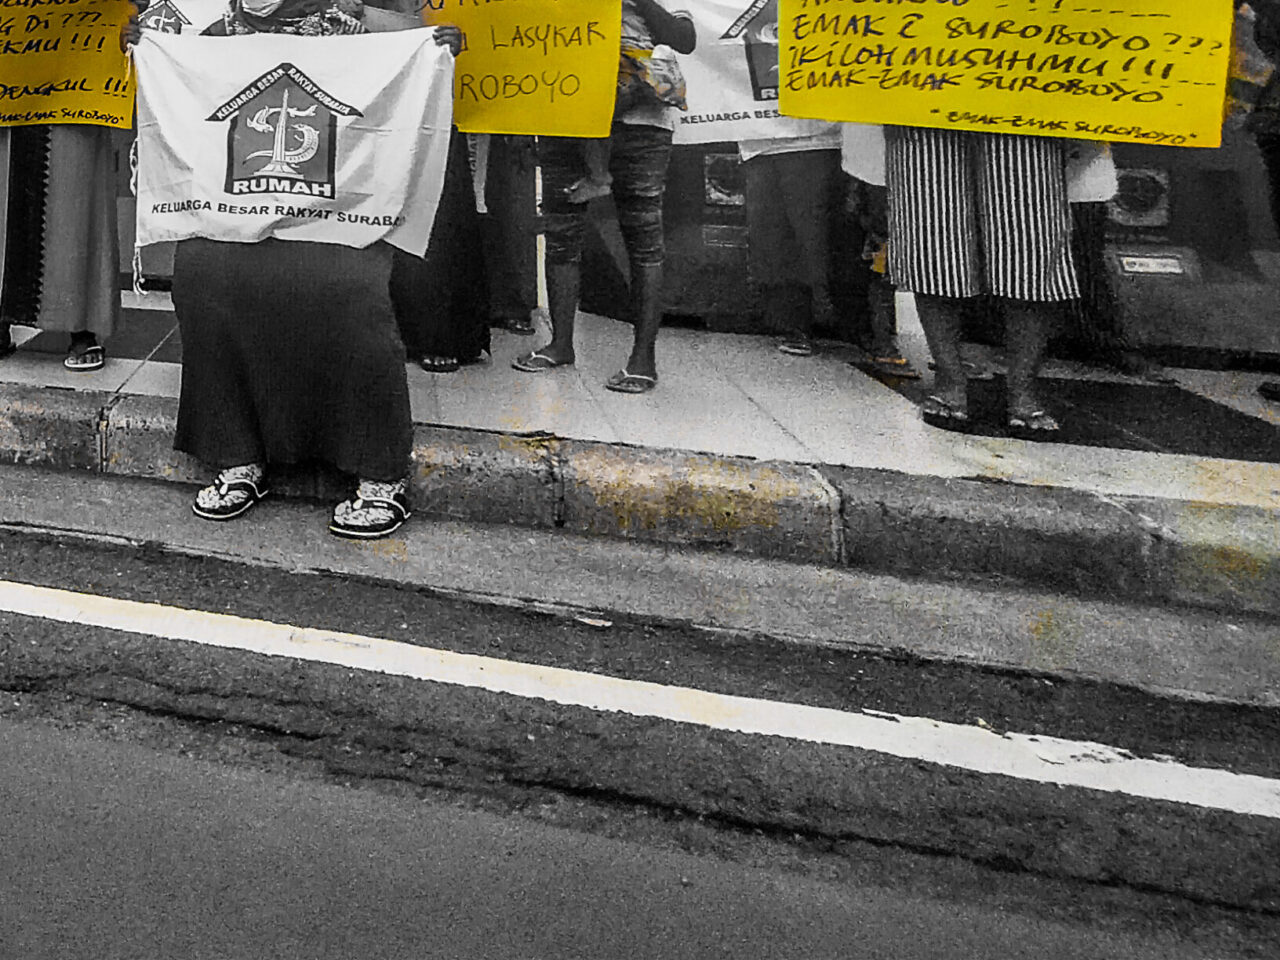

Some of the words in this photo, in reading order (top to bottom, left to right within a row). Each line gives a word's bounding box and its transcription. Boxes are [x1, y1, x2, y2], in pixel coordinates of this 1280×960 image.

[25, 12, 50, 33] DI
[792, 13, 885, 40] EMAK
[945, 16, 1151, 52] SUROBOYO
[490, 21, 606, 56] LASYKAR
[287, 67, 315, 94] RAKYAT
[785, 68, 965, 91] EMAK-EMAK
[216, 87, 259, 120] KELUARGA
[258, 68, 286, 91] BESAR
[680, 111, 751, 124] KELUARGA
[755, 109, 786, 119] BES
[232, 178, 333, 197] RUMAH
[151, 199, 212, 216] KELUARGA
[217, 202, 269, 216] BESAR
[274, 205, 333, 220] RAKYAT
